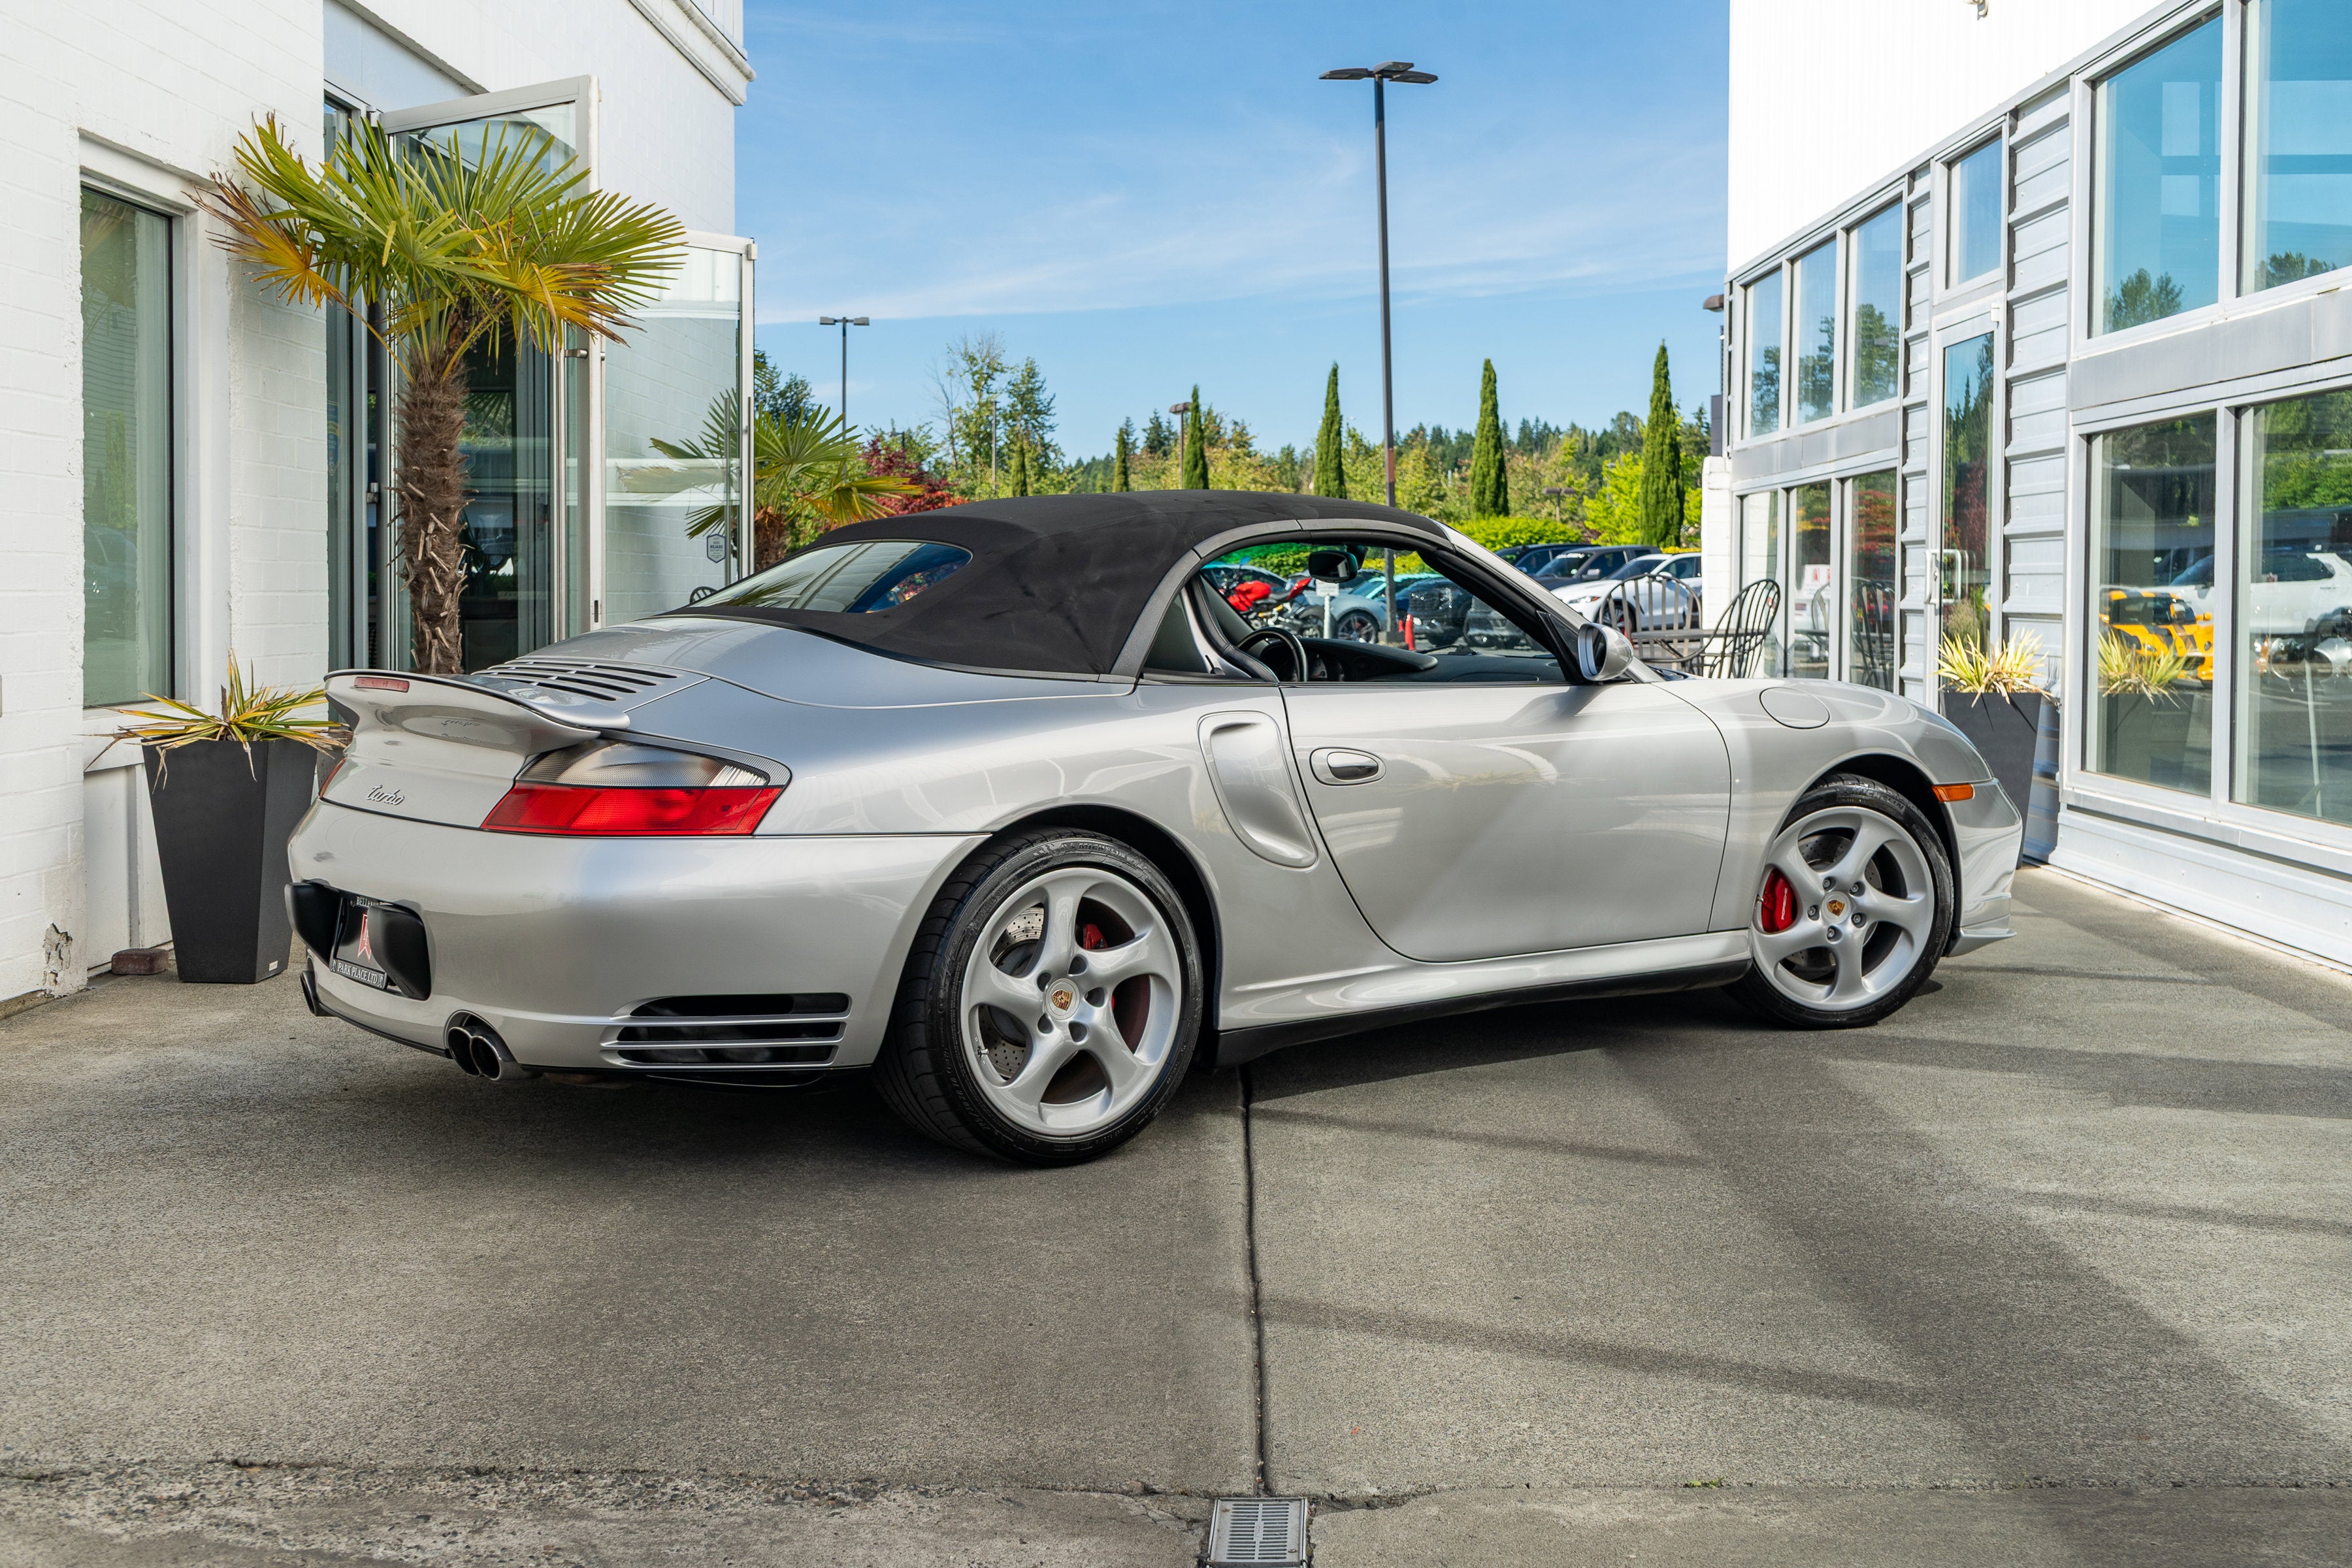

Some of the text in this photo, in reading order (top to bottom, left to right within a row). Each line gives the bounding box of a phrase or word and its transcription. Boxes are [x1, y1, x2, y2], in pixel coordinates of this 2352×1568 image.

[337, 962, 378, 984] PARK PLACE LTD
